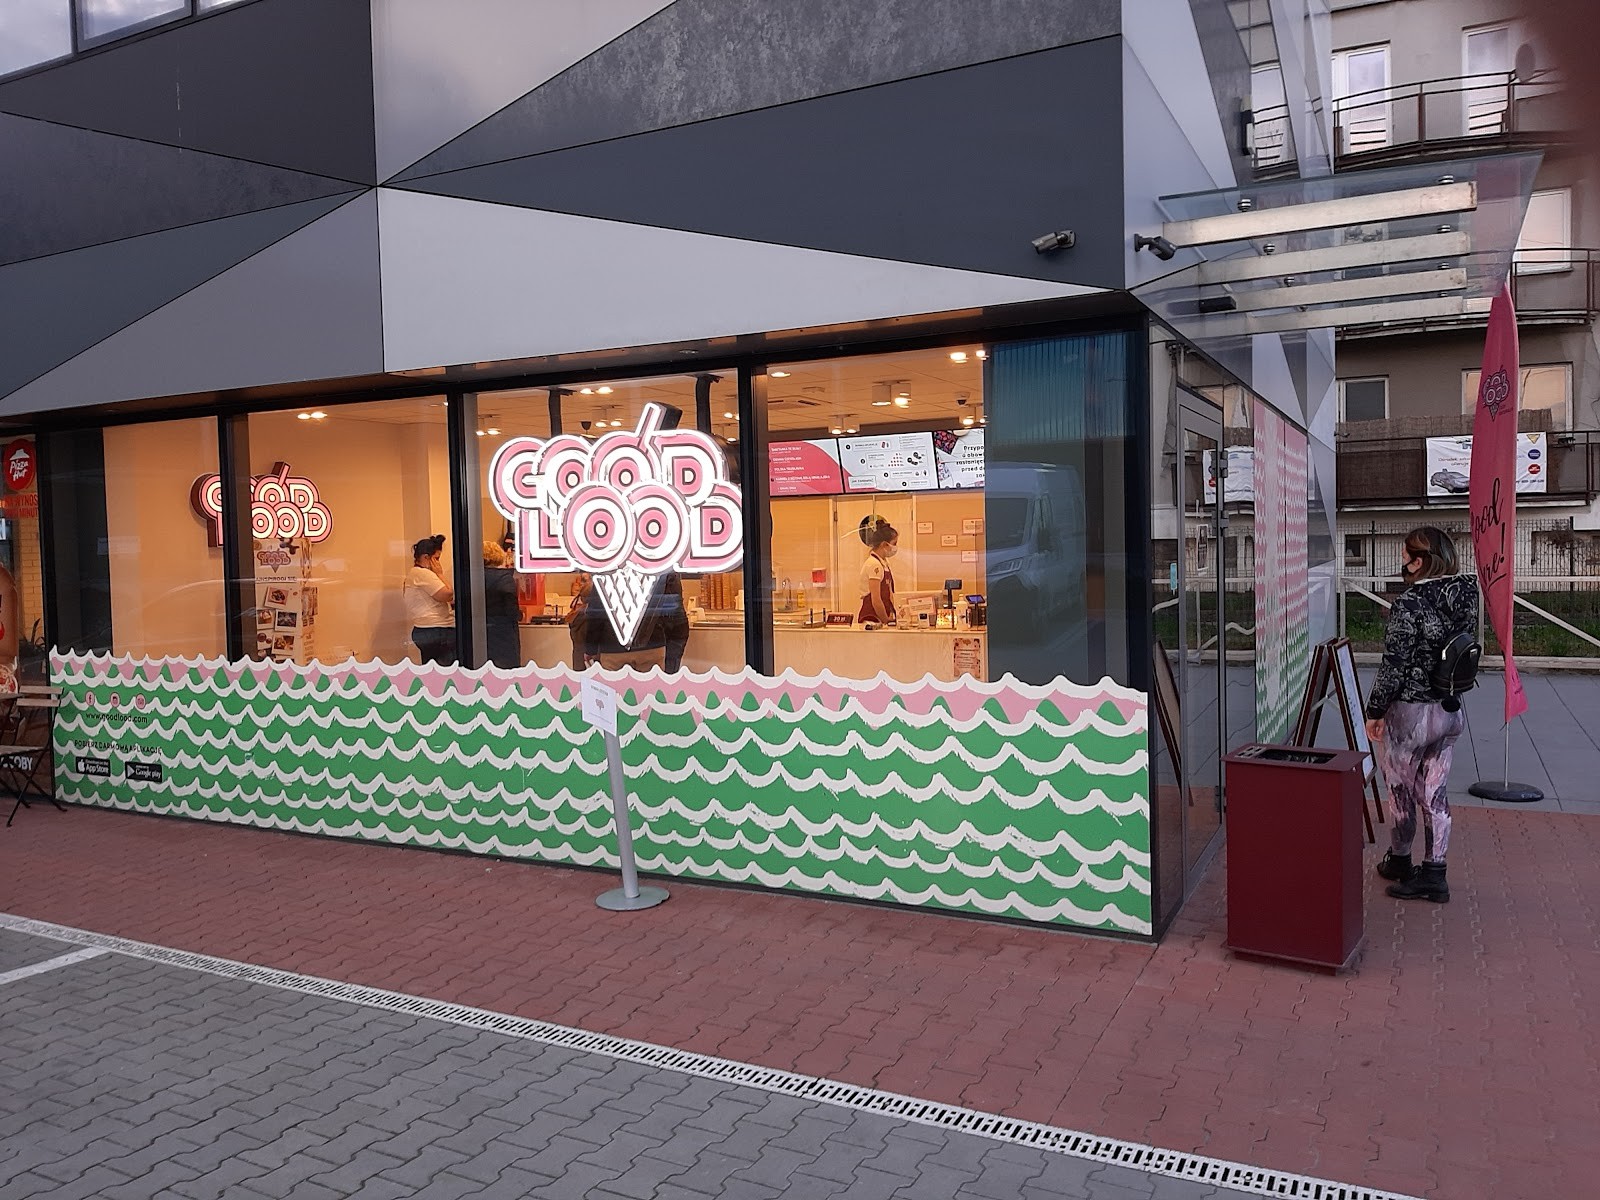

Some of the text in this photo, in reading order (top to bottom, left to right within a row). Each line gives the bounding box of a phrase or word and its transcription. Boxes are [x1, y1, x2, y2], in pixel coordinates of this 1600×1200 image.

[9, 460, 29, 474] Pizza
[13, 468, 28, 481] Hut
[217, 501, 333, 546] OOD
[515, 481, 744, 573] LOOD
[86, 713, 148, 723] www.goodlood.com
[86, 763, 96, 773] App
[135, 768, 151, 778] Google
